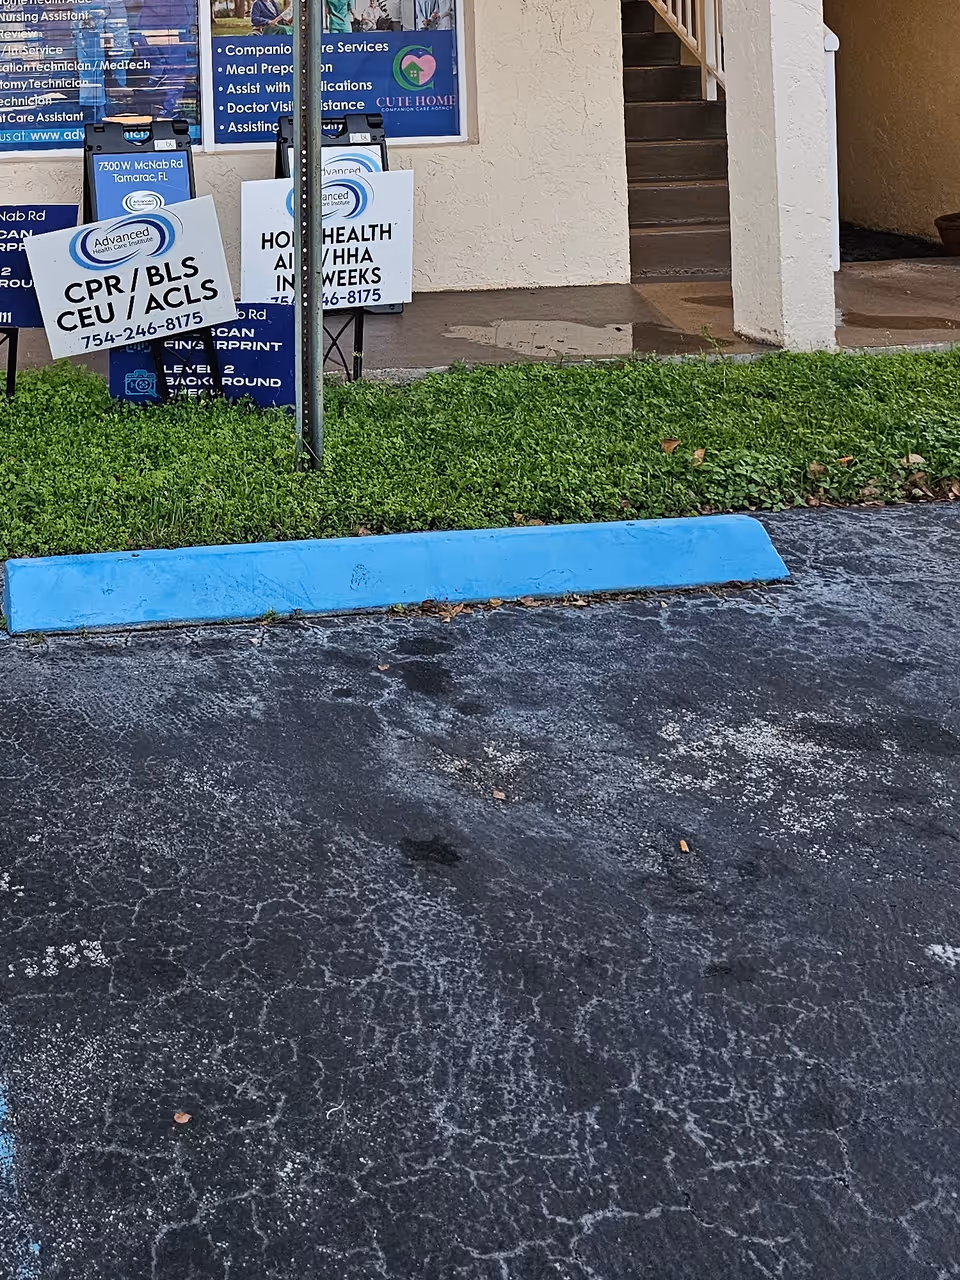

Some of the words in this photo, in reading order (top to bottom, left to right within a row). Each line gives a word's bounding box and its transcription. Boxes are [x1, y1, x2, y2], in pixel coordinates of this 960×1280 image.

[40, 11, 90, 21] Assistant
[337, 41, 389, 54] Services
[30, 62, 91, 72] Technician
[98, 60, 151, 70] MedTech
[226, 63, 258, 75] Meal
[30, 79, 89, 89] Technician
[226, 83, 261, 94] Assist
[265, 82, 291, 93] with
[376, 95, 412, 108] CUTE
[415, 94, 456, 106] HOME
[227, 102, 269, 114] Doctor
[7, 113, 34, 123] Care
[36, 111, 84, 122] Assistant
[98, 161, 121, 172] 7300
[134, 159, 169, 170] McNab
[170, 158, 184, 169] Rd
[112, 172, 157, 183] Tamarac,
[158, 171, 169, 181] FL
[27, 210, 46, 222] Rd
[93, 226, 150, 249] Advanced
[322, 223, 392, 245] HEALTH
[92, 245, 113, 255] Health
[113, 243, 128, 251] Care
[128, 235, 154, 248] Institute
[1, 267, 12, 276] 2
[64, 274, 125, 304] CPR
[146, 256, 199, 288] BLS
[276, 274, 295, 292] IN
[56, 302, 116, 332] CEU
[144, 278, 219, 315] ACLS
[249, 308, 267, 320] Rd
[80, 311, 204, 349] 754-246-8175
[163, 340, 283, 352] FINGRPRINT
[223, 364, 235, 374] 2
